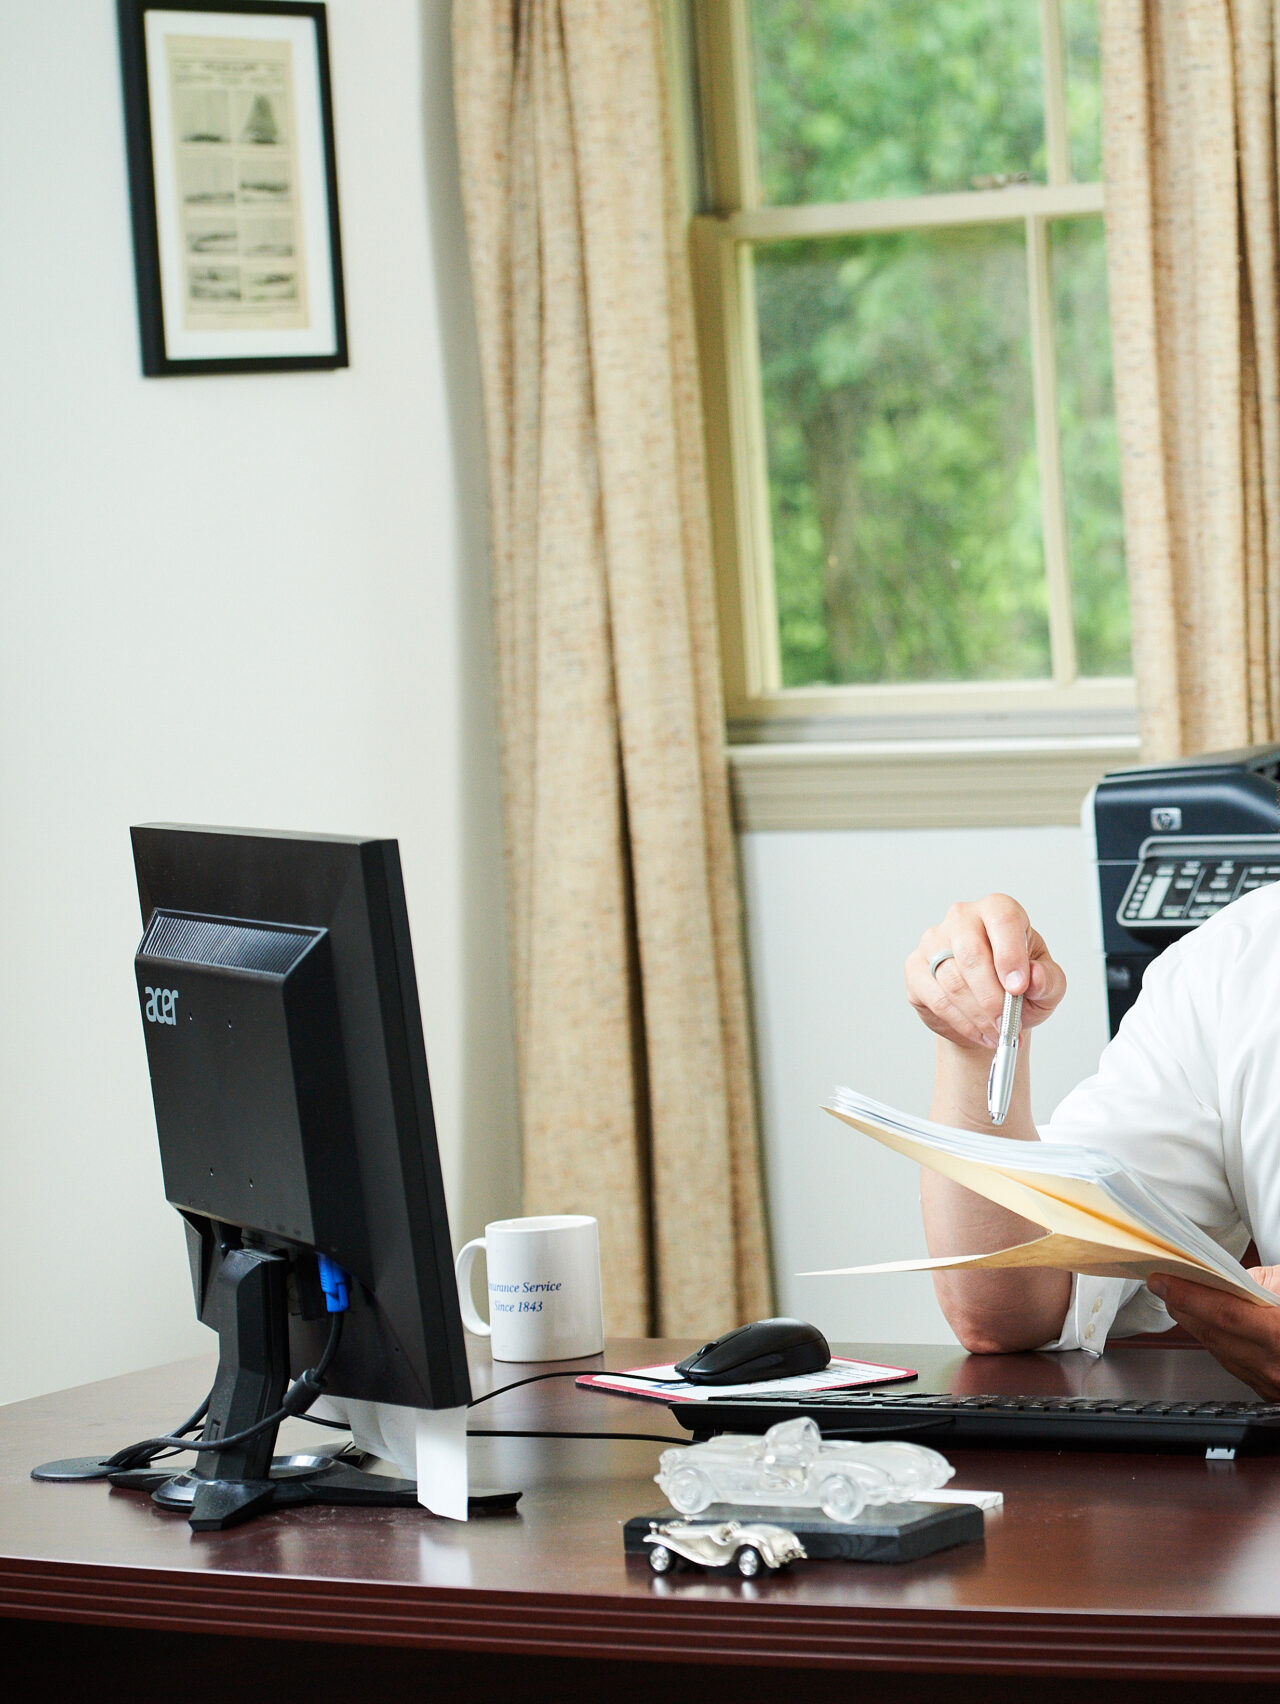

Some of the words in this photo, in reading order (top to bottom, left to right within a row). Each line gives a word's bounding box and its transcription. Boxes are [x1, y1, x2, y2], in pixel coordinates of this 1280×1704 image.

[145, 986, 178, 1025] acer
[522, 1281, 562, 1293] Service
[494, 1301, 514, 1312] Since
[518, 1301, 543, 1312] 1843
